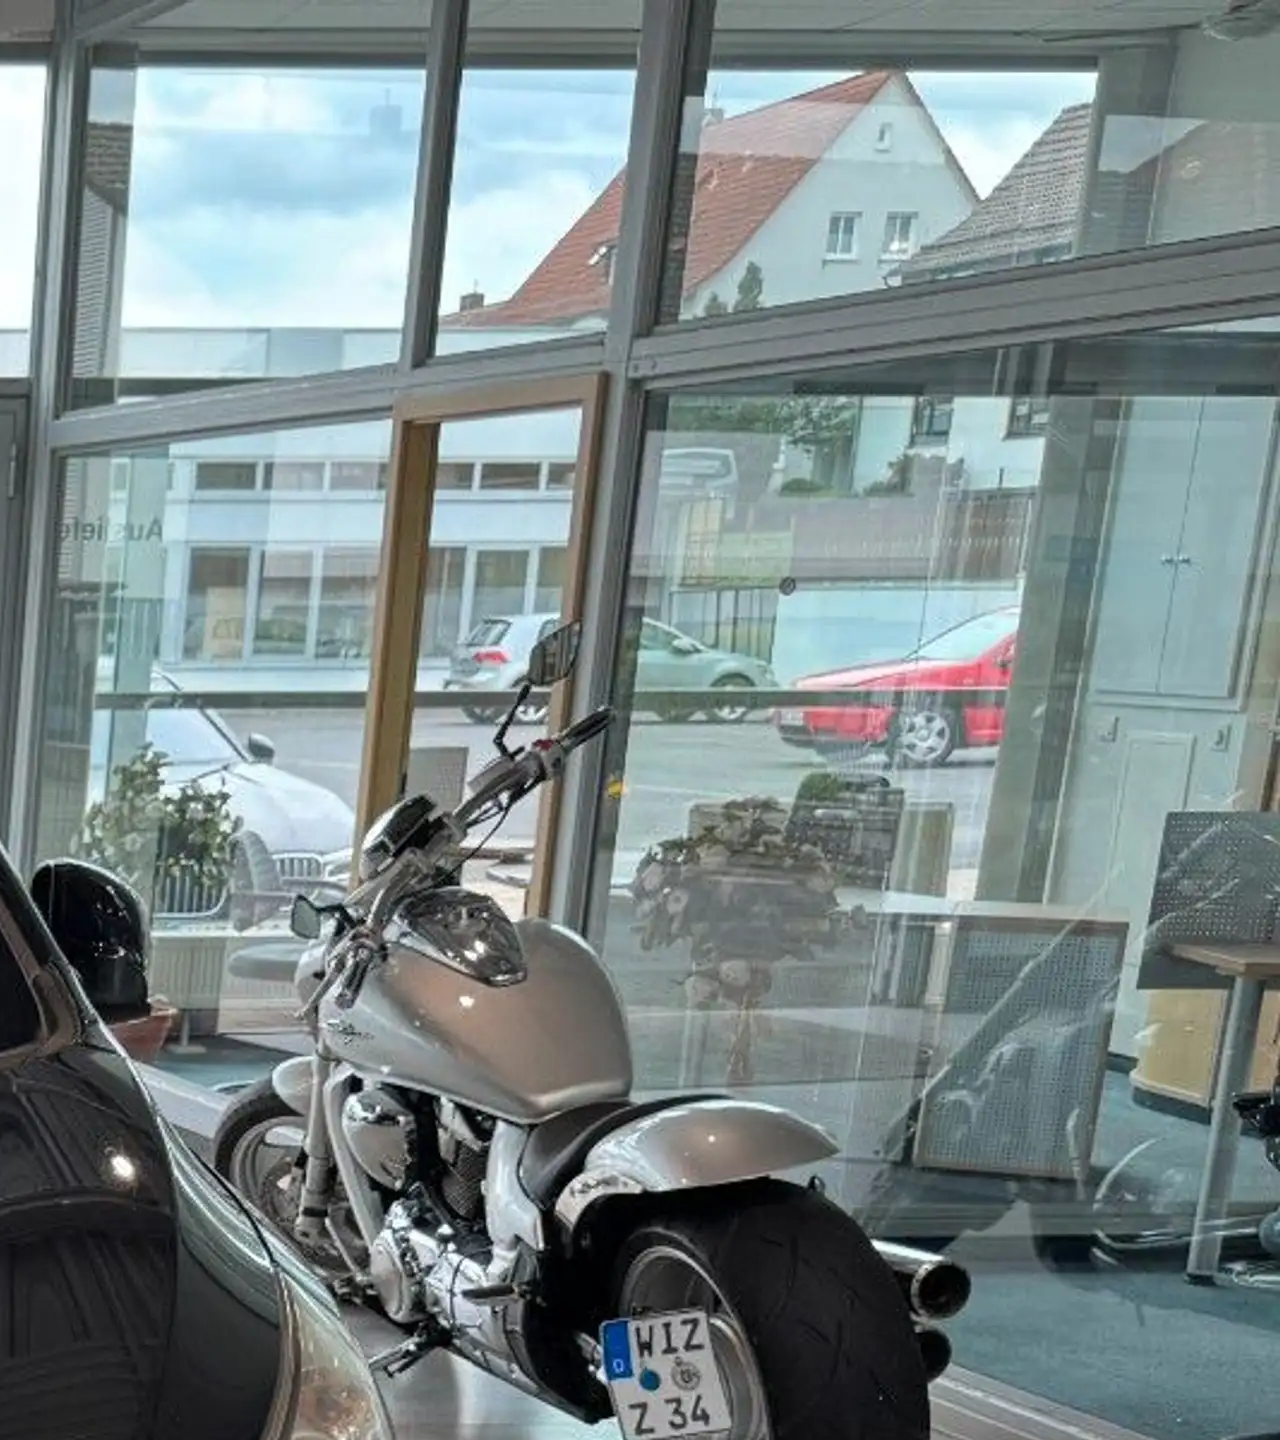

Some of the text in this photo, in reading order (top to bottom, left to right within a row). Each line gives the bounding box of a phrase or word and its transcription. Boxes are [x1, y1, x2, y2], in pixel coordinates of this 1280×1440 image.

[634, 1317, 705, 1358] WIZ
[628, 1395, 711, 1436] Z 34
